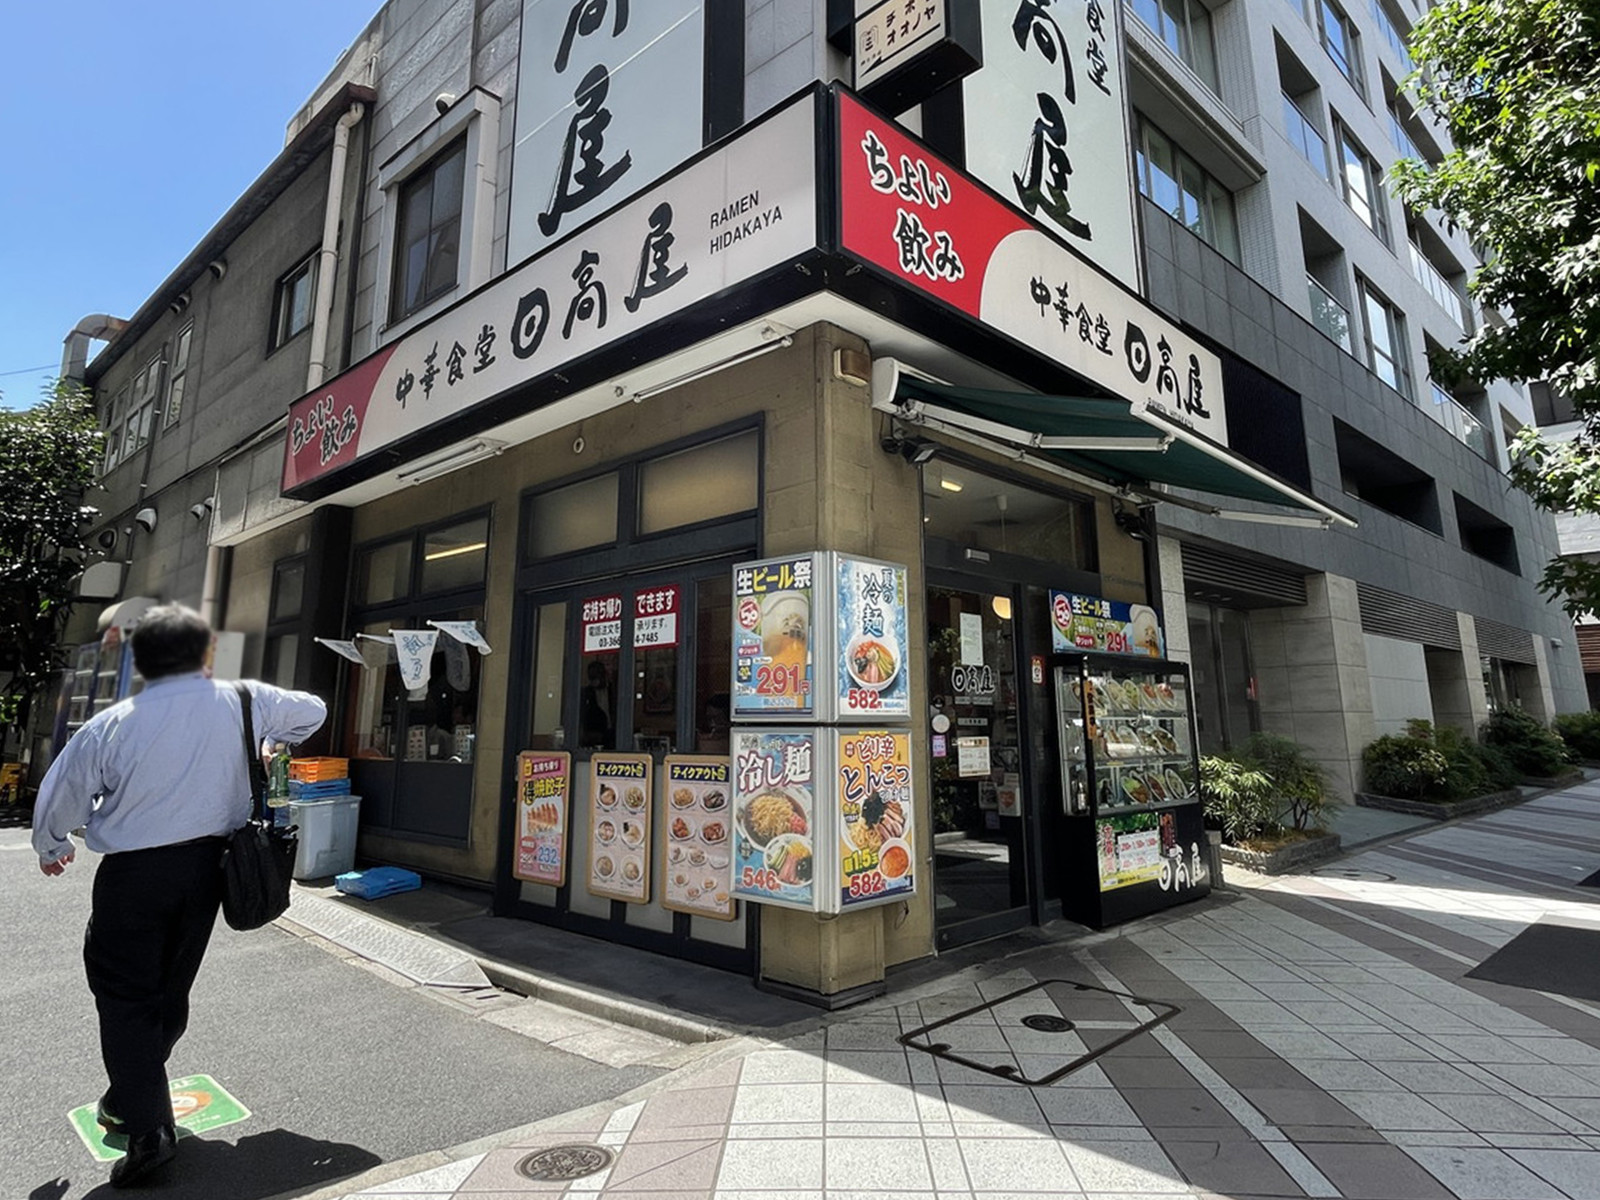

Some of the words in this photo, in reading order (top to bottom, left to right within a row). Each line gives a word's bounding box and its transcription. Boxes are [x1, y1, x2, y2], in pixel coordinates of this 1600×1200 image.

[887, 5, 936, 46] オオノヤ
[861, 130, 951, 208] ちょい
[710, 190, 759, 229] RAMEN
[710, 206, 782, 255] HIDAKAYA
[894, 208, 965, 282] 飲み
[396, 324, 497, 409] 中華食堂
[510, 202, 688, 360] 日高屋
[1030, 276, 1113, 357] 中華食堂
[1124, 320, 1211, 420] 日高屋
[292, 395, 334, 456] ちょい
[320, 405, 358, 466] 飲み
[737, 560, 812, 596] 生ビール祭
[583, 597, 622, 622] お持ち帰り
[636, 589, 675, 614] できます
[599, 763, 637, 776] テイクアウト
[737, 740, 812, 793] 冷し麺
[857, 735, 896, 762] ピリ辛
[673, 766, 718, 780] テイクアウト
[841, 762, 910, 802] とんこつ
